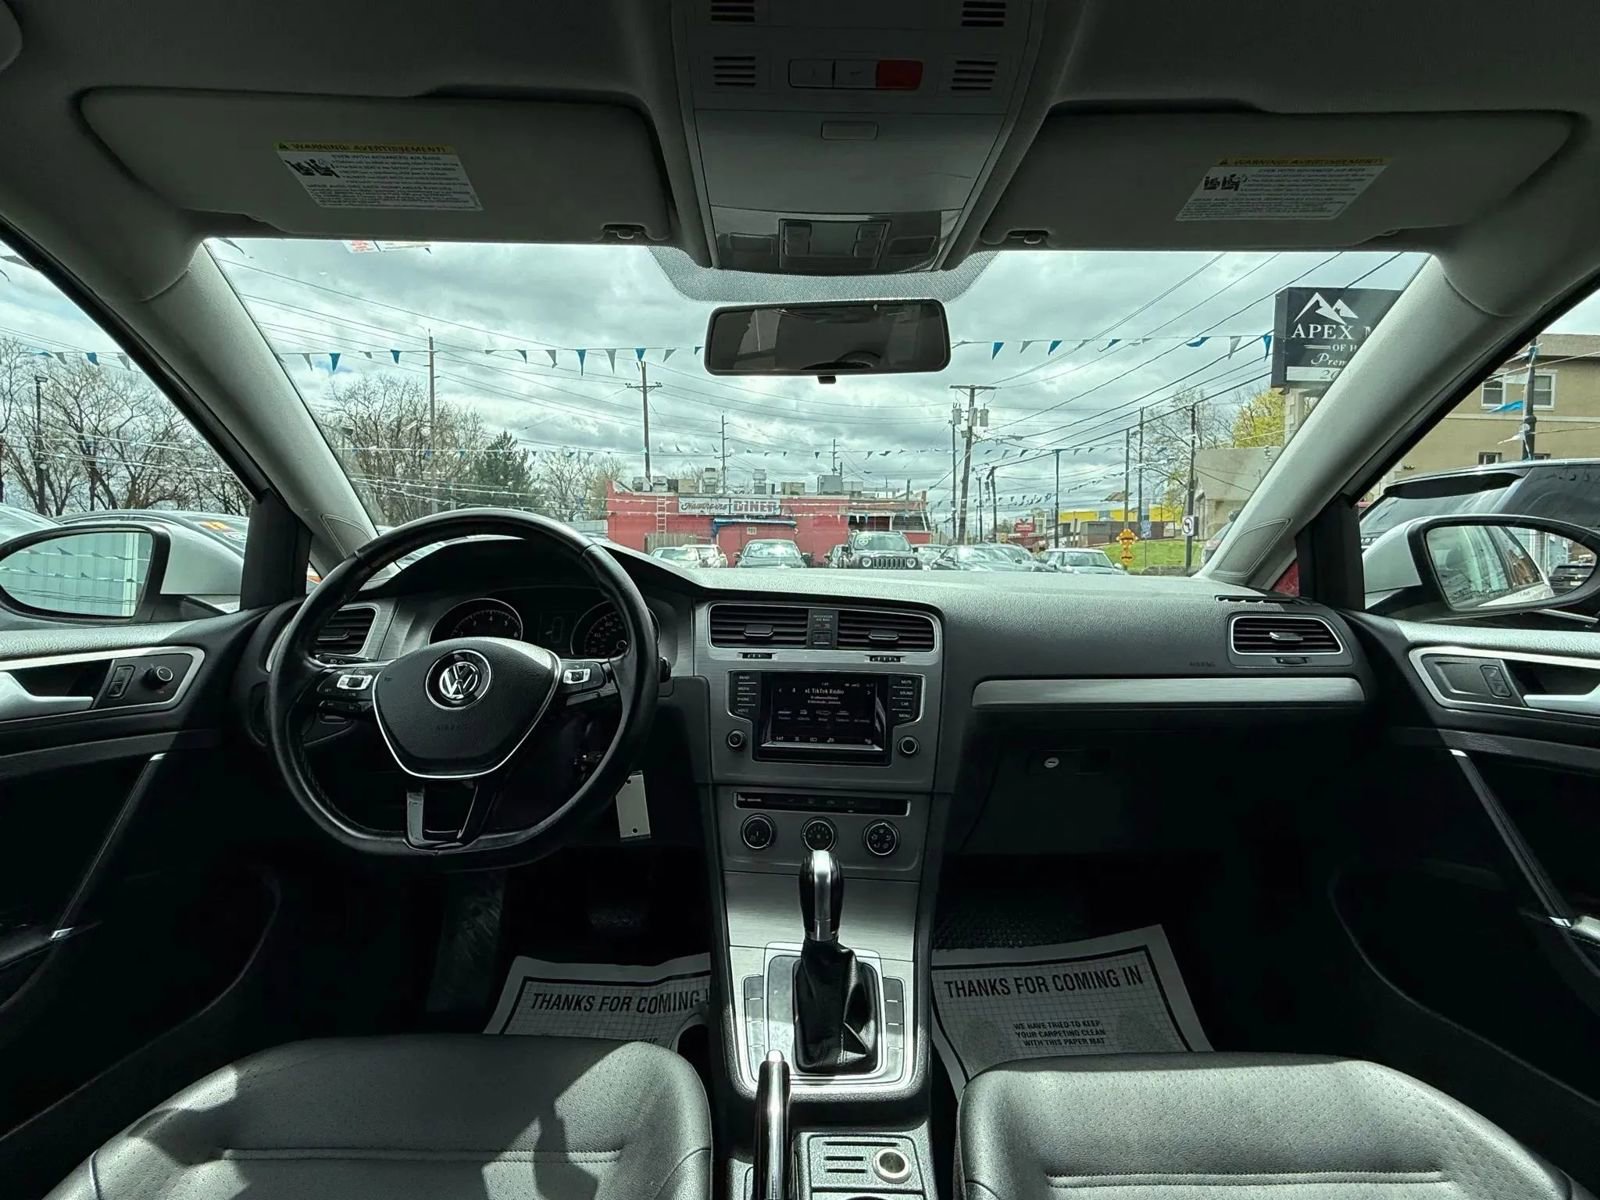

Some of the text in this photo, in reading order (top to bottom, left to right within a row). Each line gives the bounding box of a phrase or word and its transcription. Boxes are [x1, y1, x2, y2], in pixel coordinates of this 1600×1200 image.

[1291, 323, 1354, 340] APEX
[944, 965, 1144, 998] THANKS FOR COMING IN
[531, 992, 595, 1012] THANKS
[599, 995, 633, 1013] FOR
[635, 989, 700, 1014] COMING
[1070, 1020, 1081, 1028] TO
[1015, 1031, 1037, 1039] YOUR
[1039, 1029, 1080, 1038] CARPETING
[1063, 1038, 1088, 1046] PAPER
[1089, 1037, 1105, 1045] MAT
